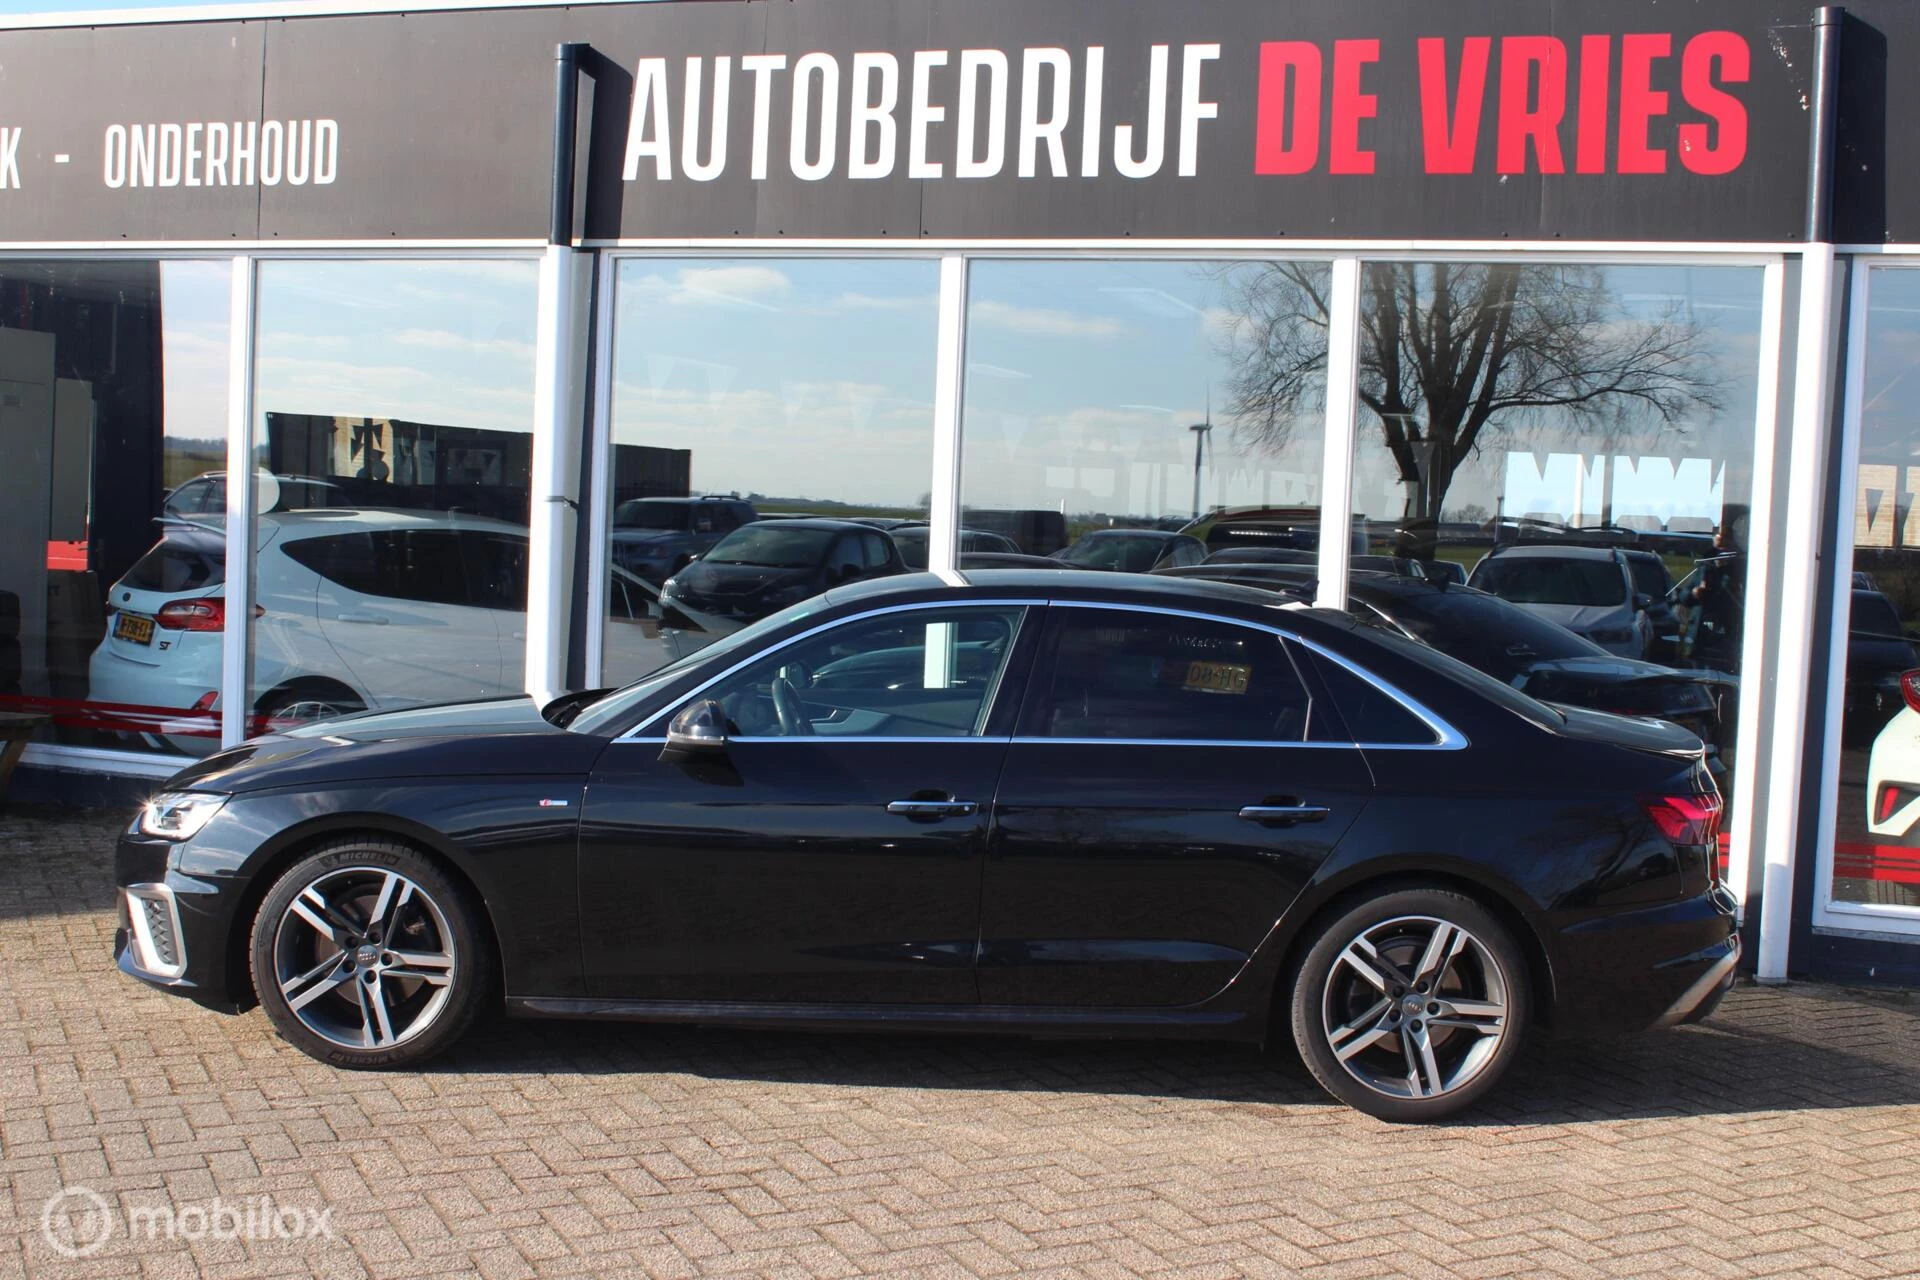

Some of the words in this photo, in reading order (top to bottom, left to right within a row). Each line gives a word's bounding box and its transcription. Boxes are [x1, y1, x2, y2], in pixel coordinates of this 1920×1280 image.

[104, 119, 338, 188] ONDERHOUD
[622, 43, 1220, 181] AUTOBEDRIJF
[1255, 39, 1380, 175] DE
[1418, 31, 1751, 175] VRIES
